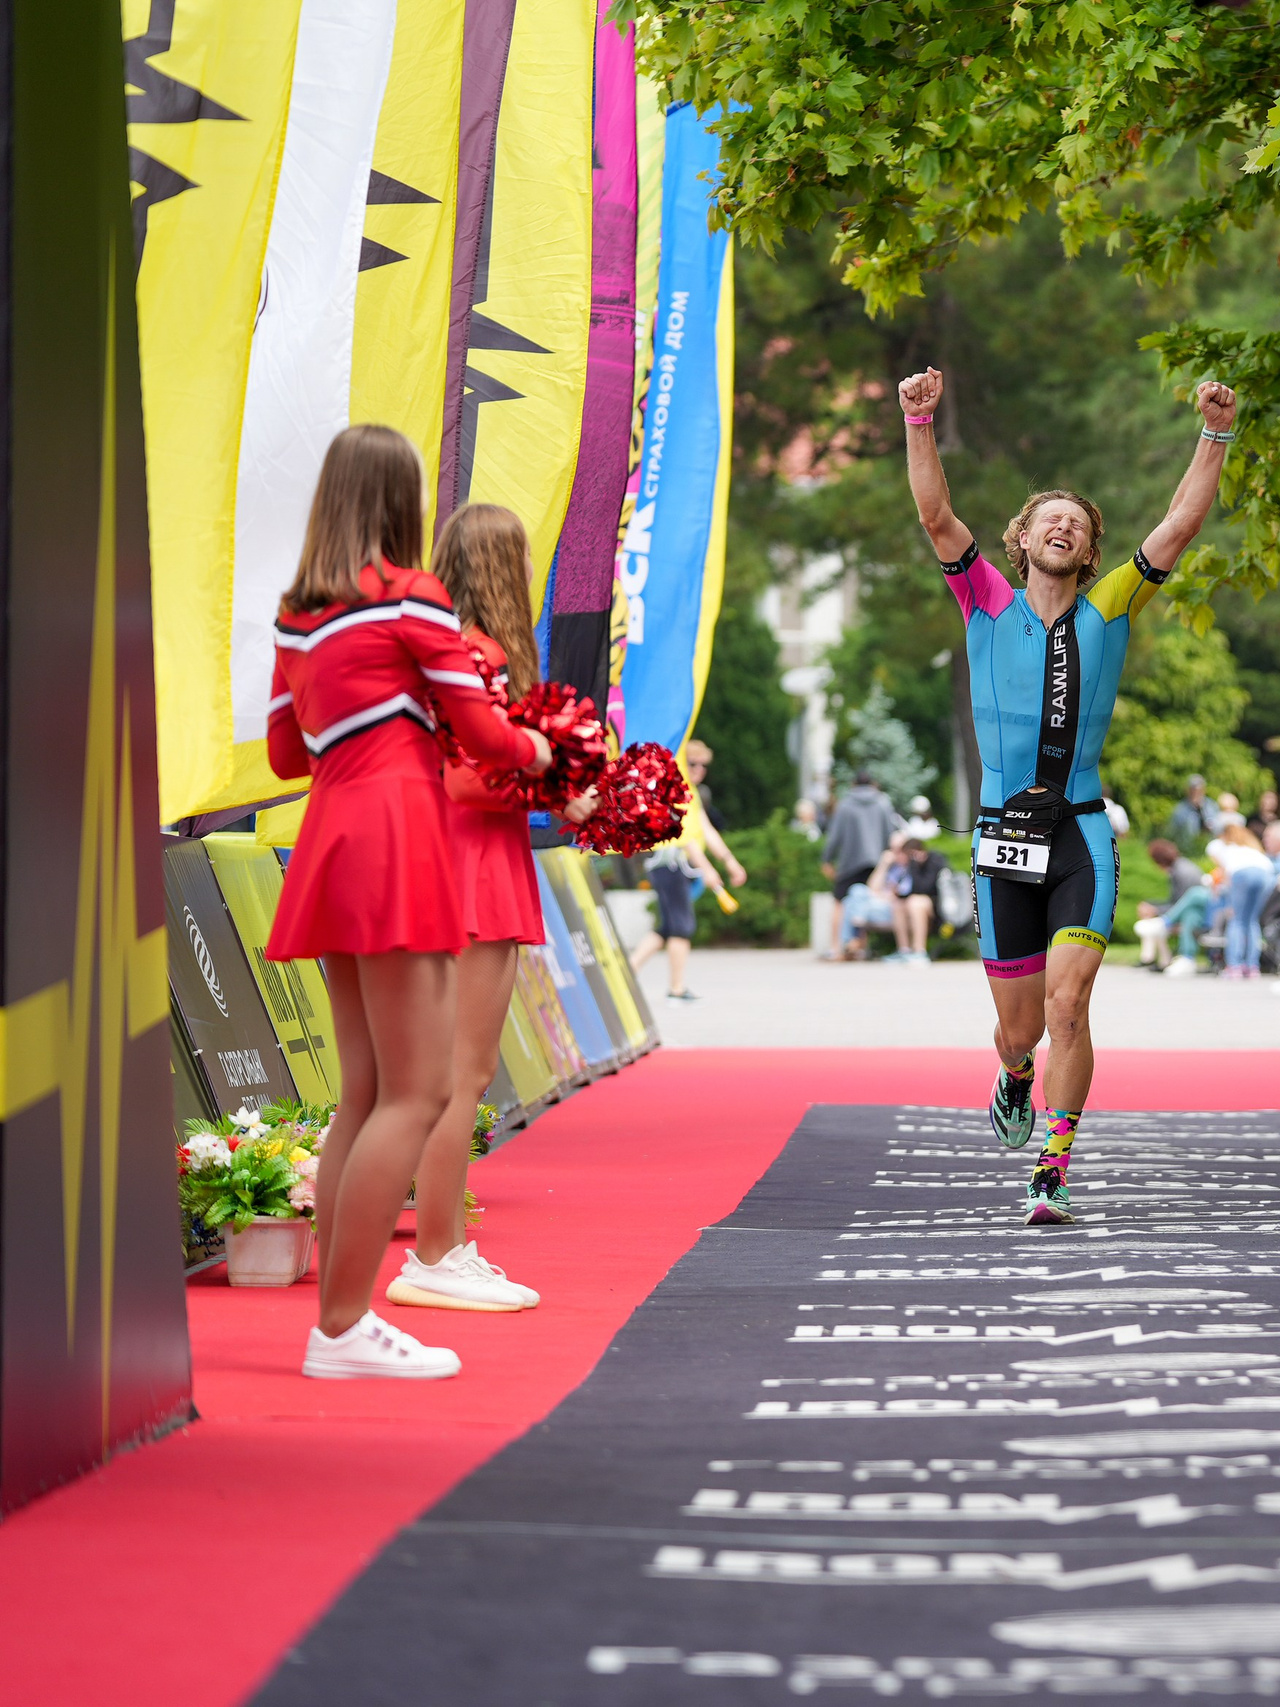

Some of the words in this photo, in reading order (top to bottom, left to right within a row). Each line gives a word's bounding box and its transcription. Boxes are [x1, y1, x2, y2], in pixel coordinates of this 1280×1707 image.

[622, 501, 656, 645] ВСК
[644, 353, 677, 498] СТРАХОВОЙ
[664, 291, 690, 350] ДОМ
[1050, 623, 1068, 728] R.A.W.LIFE
[1042, 744, 1066, 755] SPORT
[1042, 750, 1062, 759] TEAM
[1005, 810, 1032, 819] 2XU
[996, 845, 1029, 867] 521
[1067, 931, 1092, 941] NUTS
[994, 963, 1025, 972] ENERGY
[818, 1266, 1050, 1278] IRON
[793, 1324, 1057, 1338] IRON
[752, 1397, 1060, 1415] IRON
[688, 1487, 1061, 1517] IRON
[651, 1544, 1063, 1580] IRON
